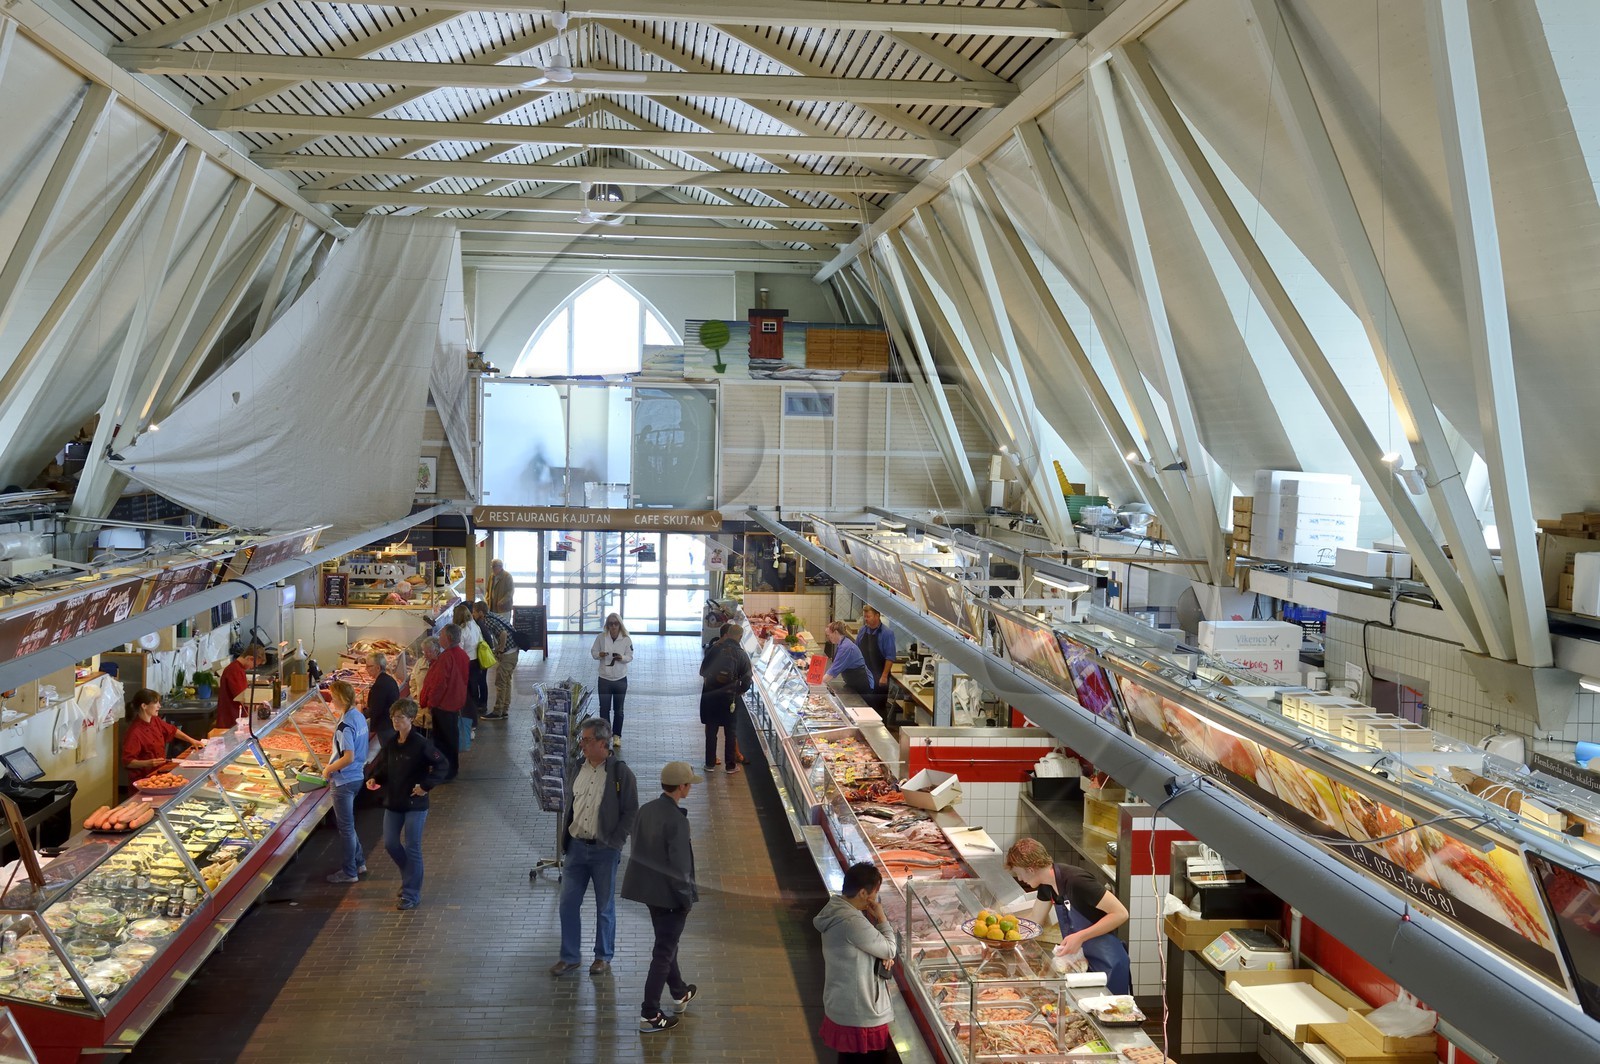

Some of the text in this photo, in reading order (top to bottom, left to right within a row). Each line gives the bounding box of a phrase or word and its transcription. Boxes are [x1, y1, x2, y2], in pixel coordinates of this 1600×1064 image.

[489, 511, 611, 524] RESTAURANG KAJUTAN
[634, 514, 704, 526] CAFE SKUTAN
[1235, 634, 1268, 643] Vikenco
[1373, 856, 1418, 894] 031-13
